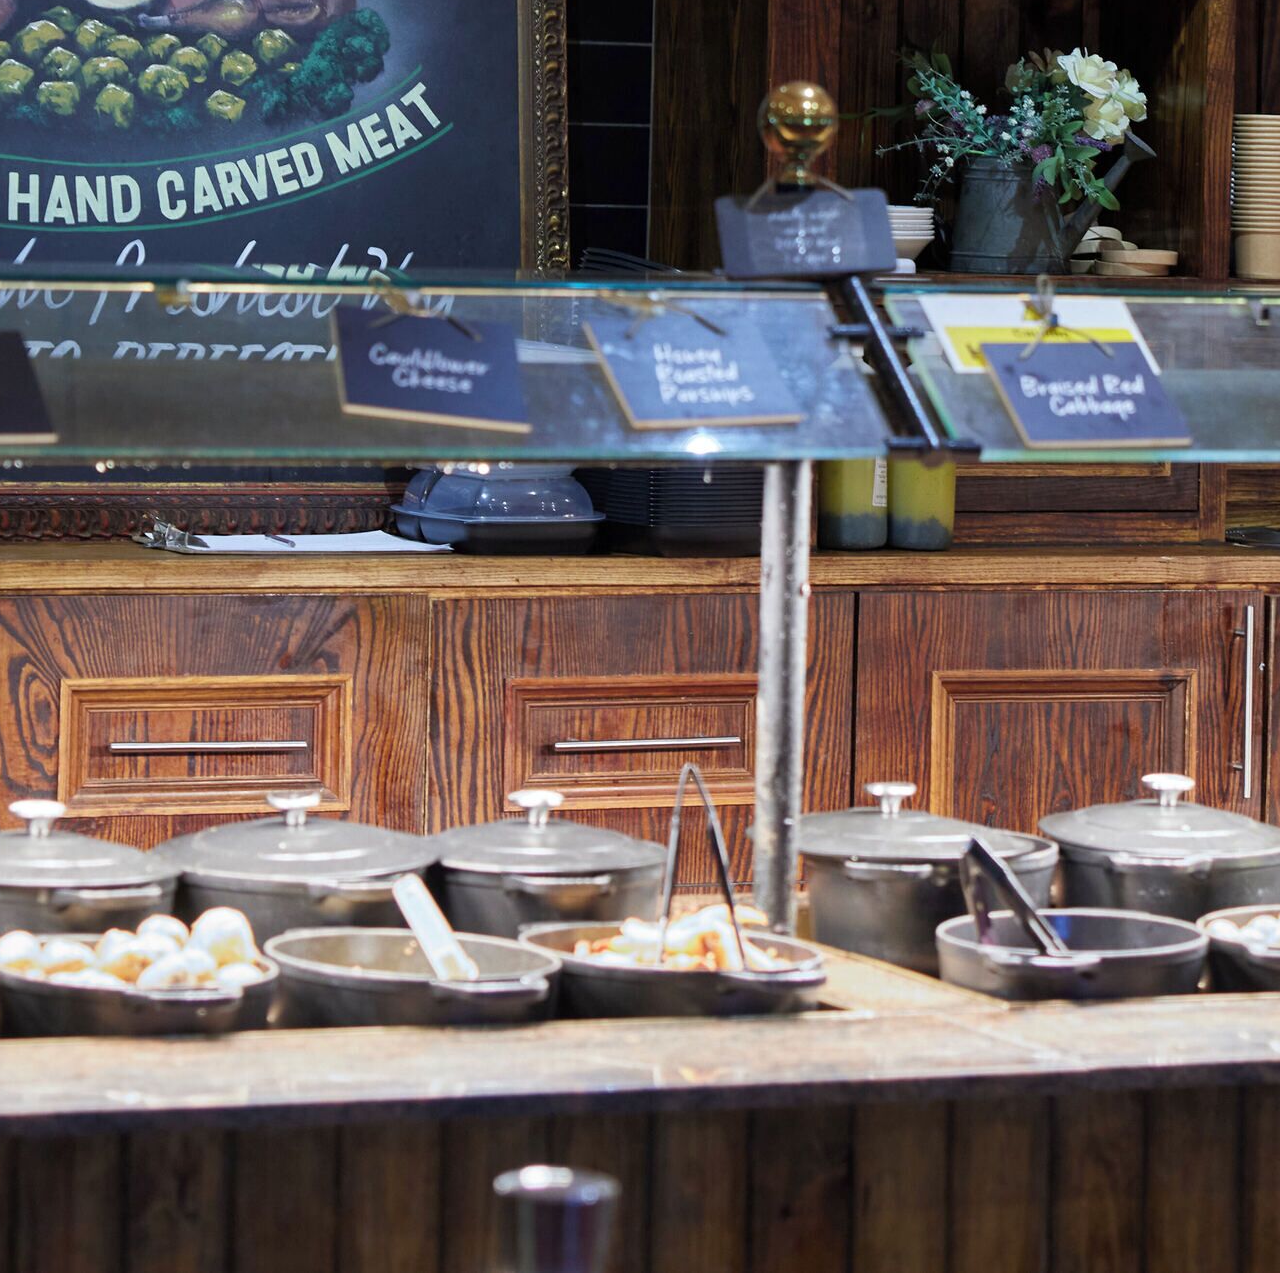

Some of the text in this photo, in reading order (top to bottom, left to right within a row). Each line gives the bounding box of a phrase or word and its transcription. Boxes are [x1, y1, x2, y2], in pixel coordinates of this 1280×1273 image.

[7, 172, 141, 224] HAND
[157, 141, 323, 221] CARVED
[325, 82, 442, 173] MEAT
[368, 342, 490, 376] Cauliflower
[653, 342, 722, 366] Honey
[392, 366, 472, 394] Cheese
[656, 360, 738, 384] Roasted
[659, 383, 755, 407] Parsnips
[1020, 374, 1144, 398] Braised Red
[1049, 396, 1136, 421] Cabbage
